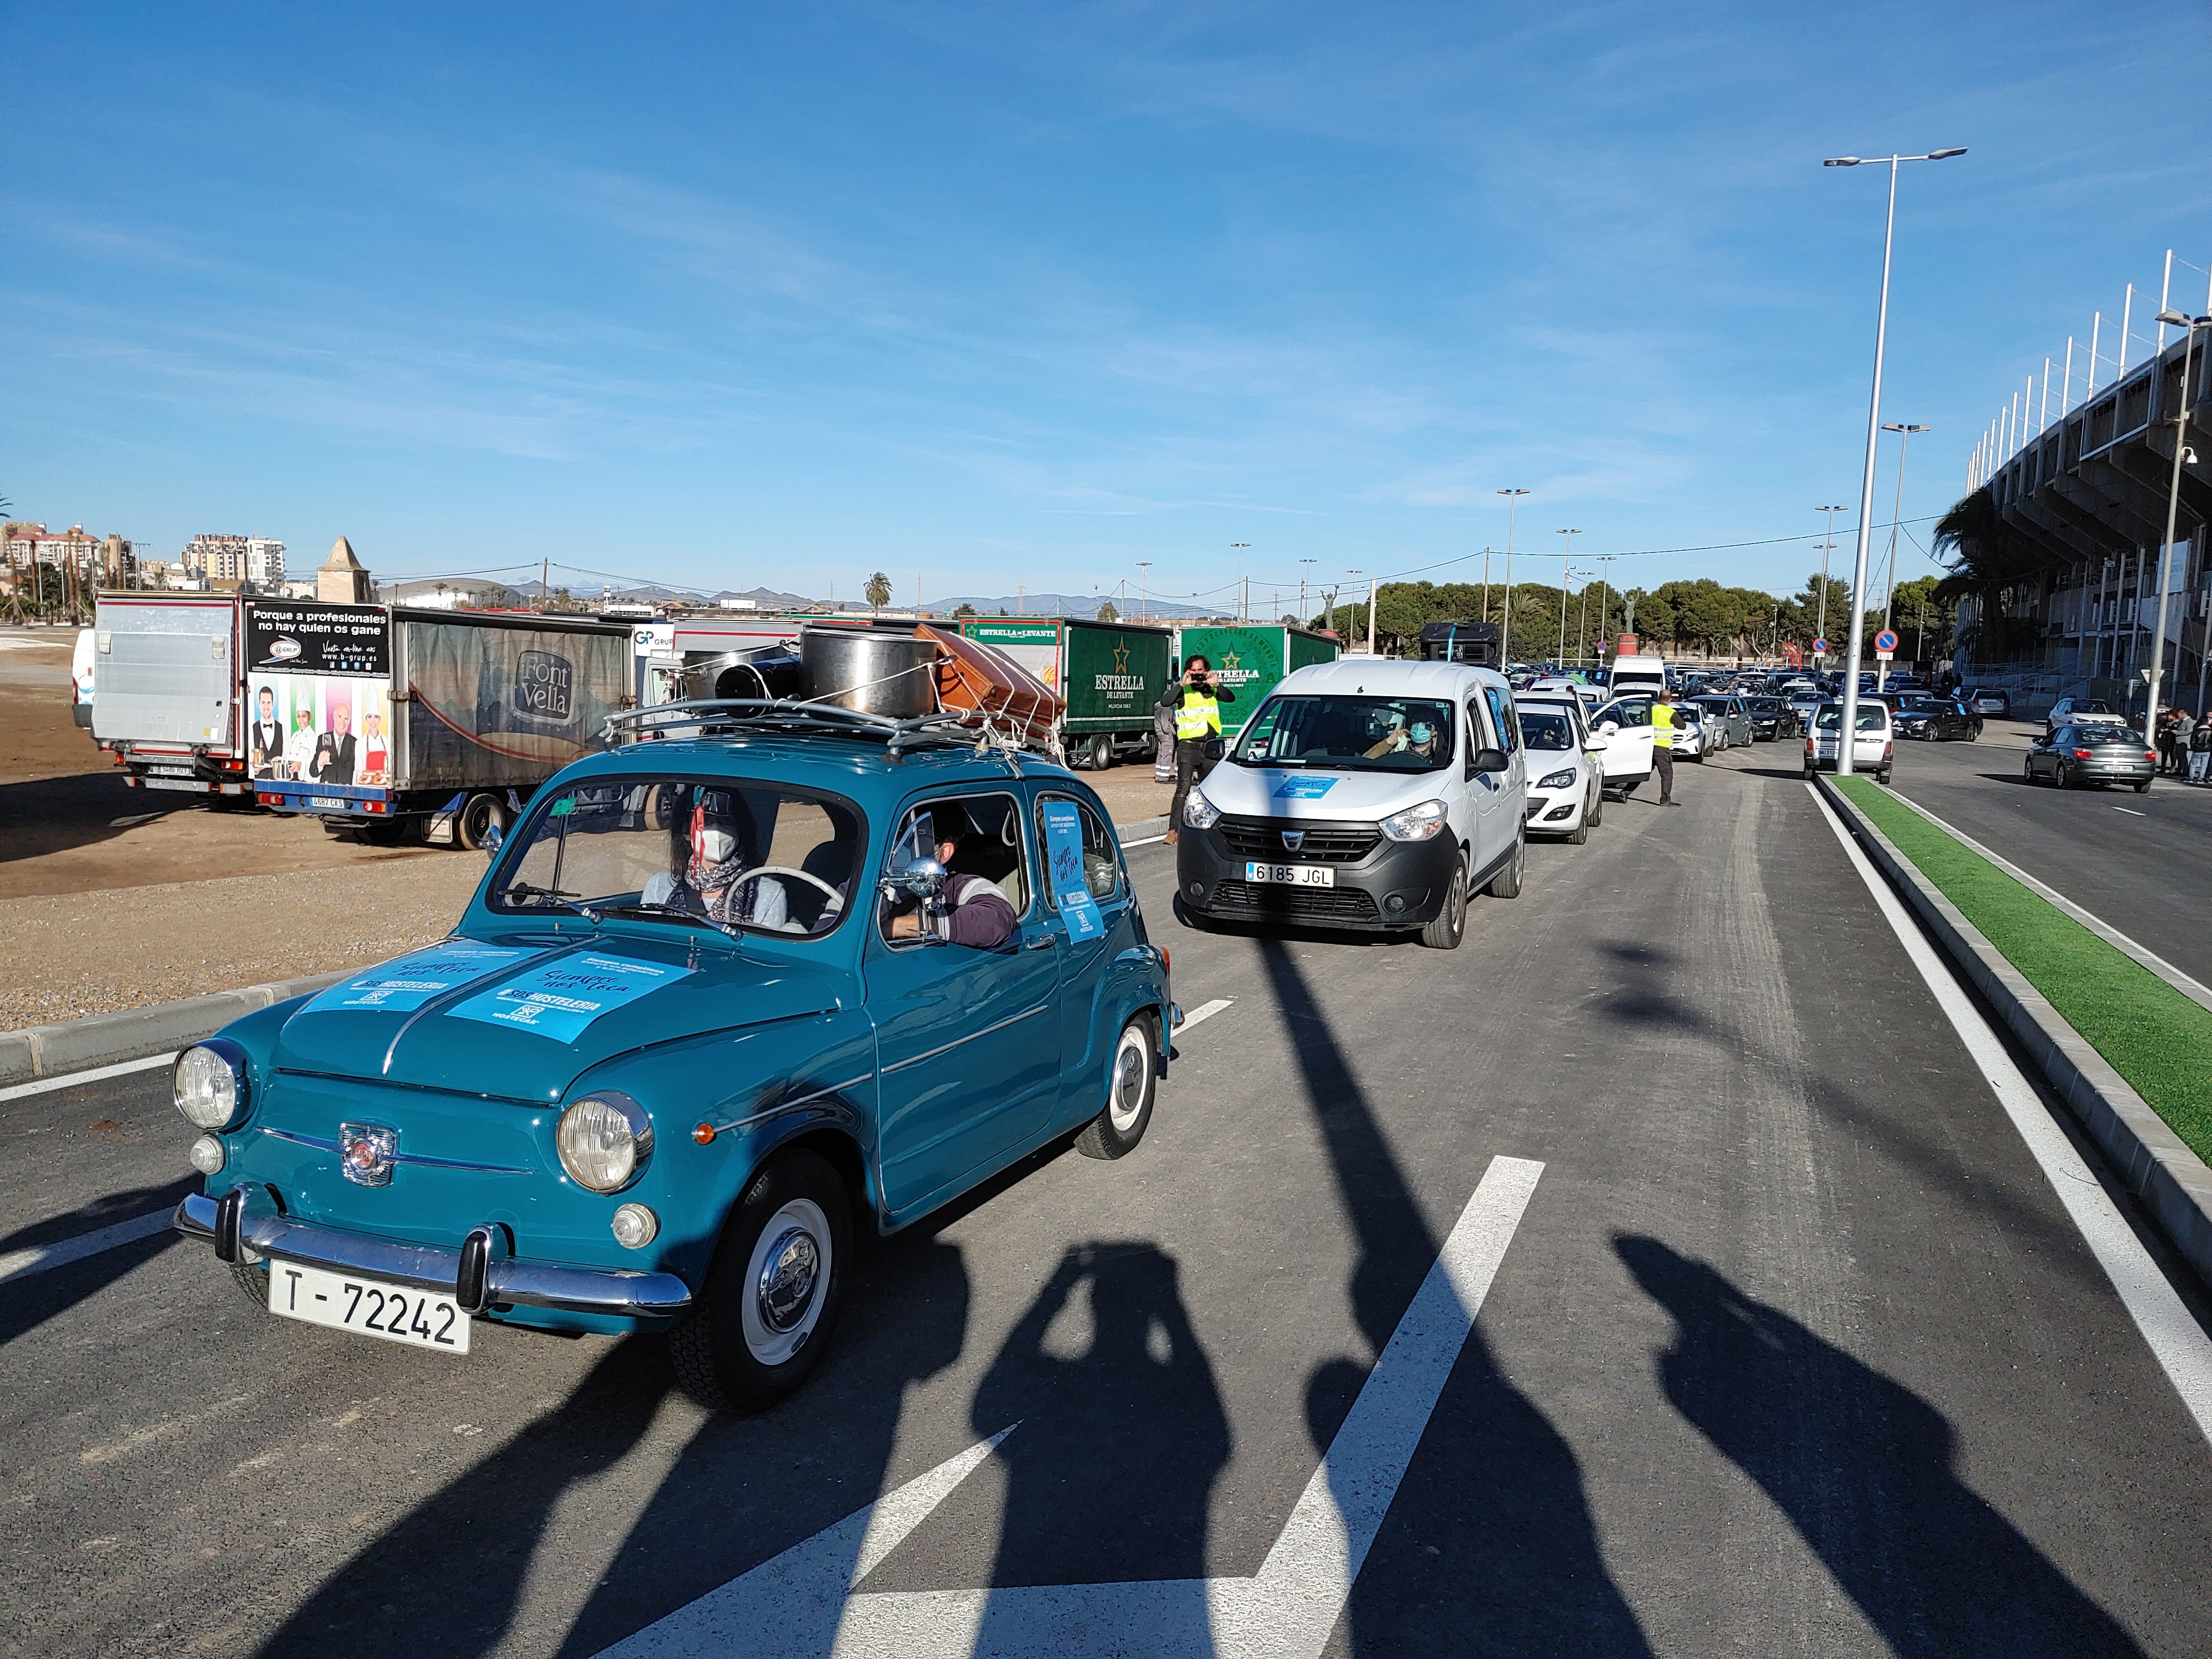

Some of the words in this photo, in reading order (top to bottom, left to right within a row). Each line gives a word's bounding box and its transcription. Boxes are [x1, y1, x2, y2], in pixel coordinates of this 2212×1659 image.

[253, 611, 293, 622] Porque
[307, 612, 387, 624] profesionales
[258, 622, 273, 630] no
[276, 622, 296, 633] hay
[299, 624, 331, 633] quien
[334, 625, 348, 634] os
[351, 627, 381, 635] gane
[322, 639, 341, 653] Venta
[521, 655, 567, 688] Font
[1212, 669, 1259, 678] TRELLA
[1095, 674, 1144, 690] ESTRELLA
[521, 682, 569, 714] Vella
[314, 799, 328, 807] 4687
[1256, 865, 1294, 881] 6185
[1302, 869, 1330, 885] JGL
[536, 969, 619, 985] Siempre
[542, 979, 577, 989] nos
[586, 980, 633, 992] toca
[285, 1269, 302, 1311] T
[344, 1282, 456, 1345] 72242
